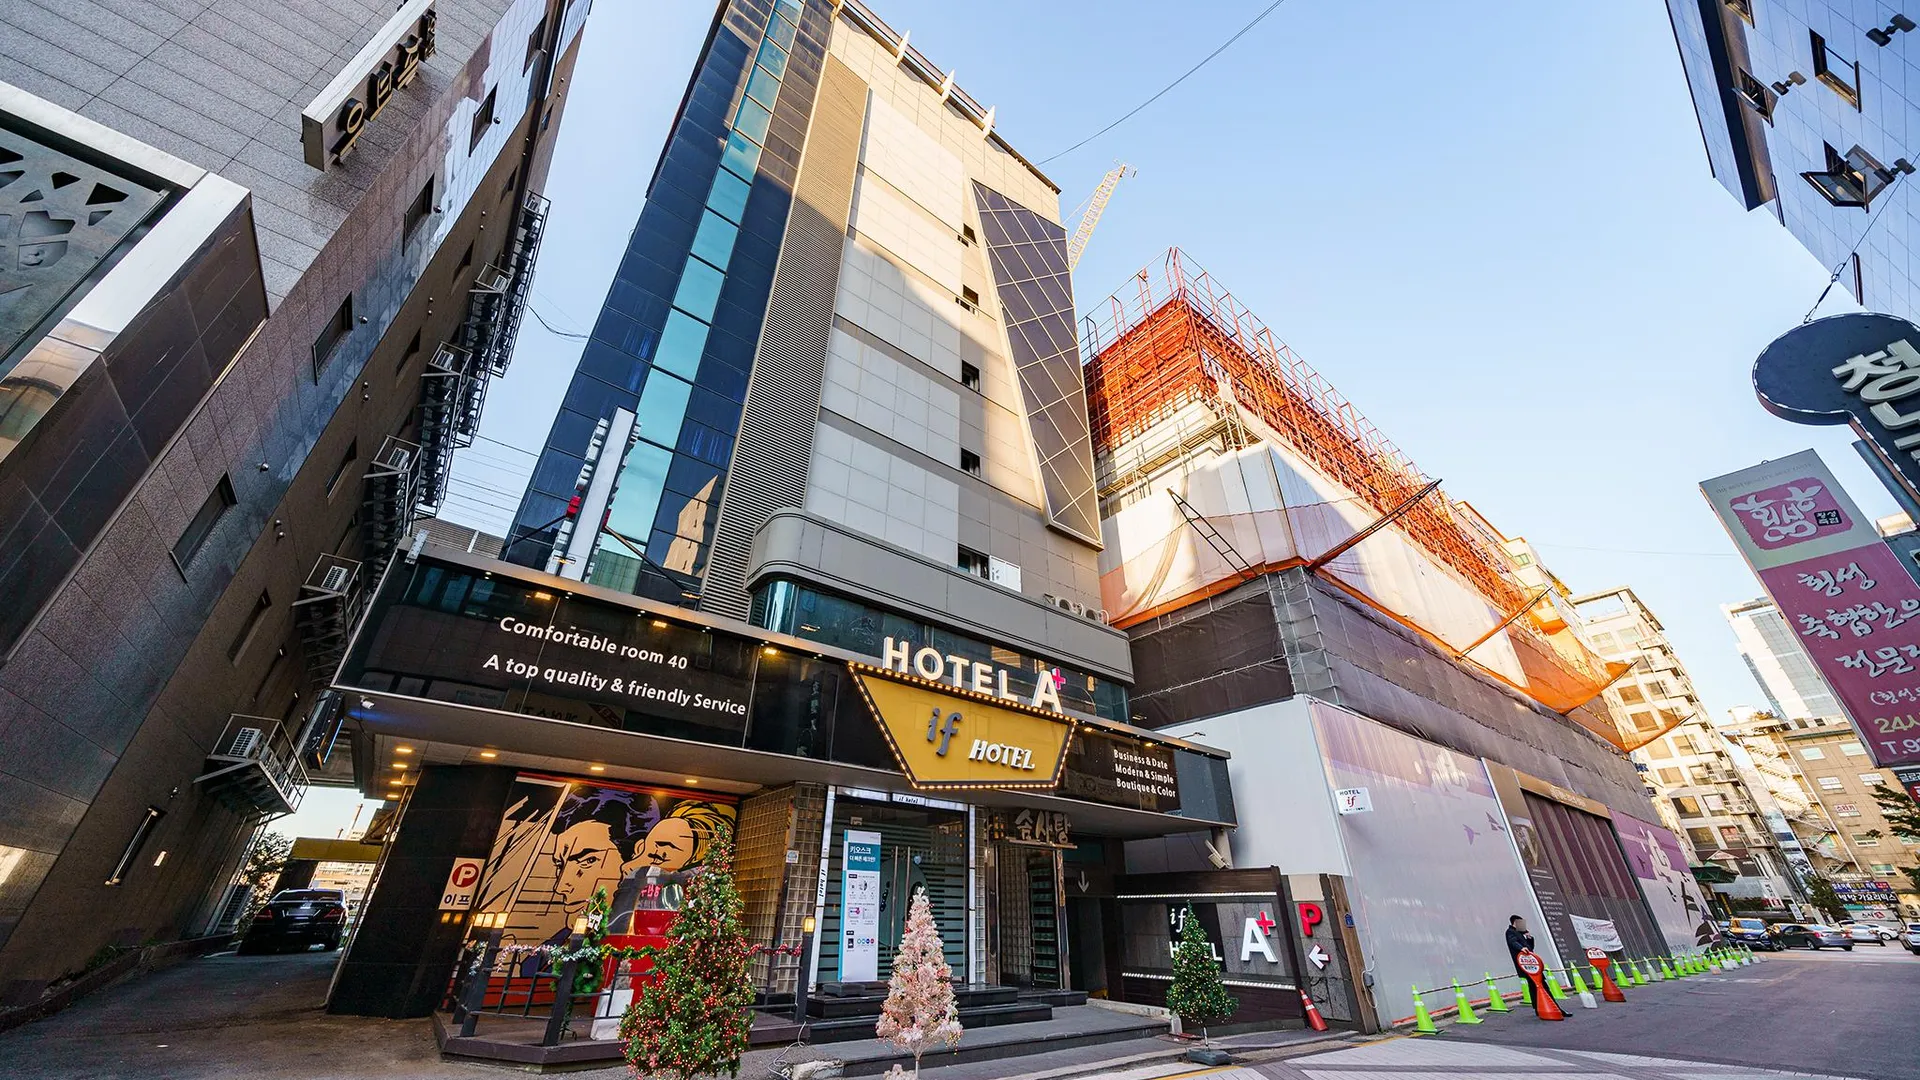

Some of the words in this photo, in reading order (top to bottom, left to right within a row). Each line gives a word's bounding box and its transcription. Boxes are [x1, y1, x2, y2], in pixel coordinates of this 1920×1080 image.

[1797, 562, 1877, 597] 횡성
[500, 616, 617, 653] Comfortable
[621, 647, 664, 665] room
[667, 655, 688, 670] 40
[882, 636, 1018, 701] HOTEL
[483, 654, 500, 671] A
[506, 656, 539, 678] top
[543, 666, 607, 691] quality
[610, 678, 623, 693] &
[628, 681, 690, 707] friendly
[694, 694, 746, 716] Service
[1870, 687, 1920, 705] (횡성
[927, 707, 963, 758] if
[968, 738, 1036, 770] HOTEL
[1880, 738, 1920, 755] T.9
[1113, 749, 1145, 764] Business
[1146, 757, 1151, 766] &
[1152, 758, 1168, 770] Date
[1115, 763, 1144, 778] Modern
[1145, 769, 1150, 780] &
[1151, 771, 1174, 784] Simple
[1116, 777, 1150, 793] Boutique
[1151, 785, 1156, 794] &
[1157, 786, 1176, 798] Color
[1347, 796, 1356, 807] if
[850, 845, 871, 855] 키오스크
[456, 866, 477, 886] P
[444, 894, 470, 906] 이프
[1170, 908, 1187, 933] if
[1299, 903, 1323, 936] P
